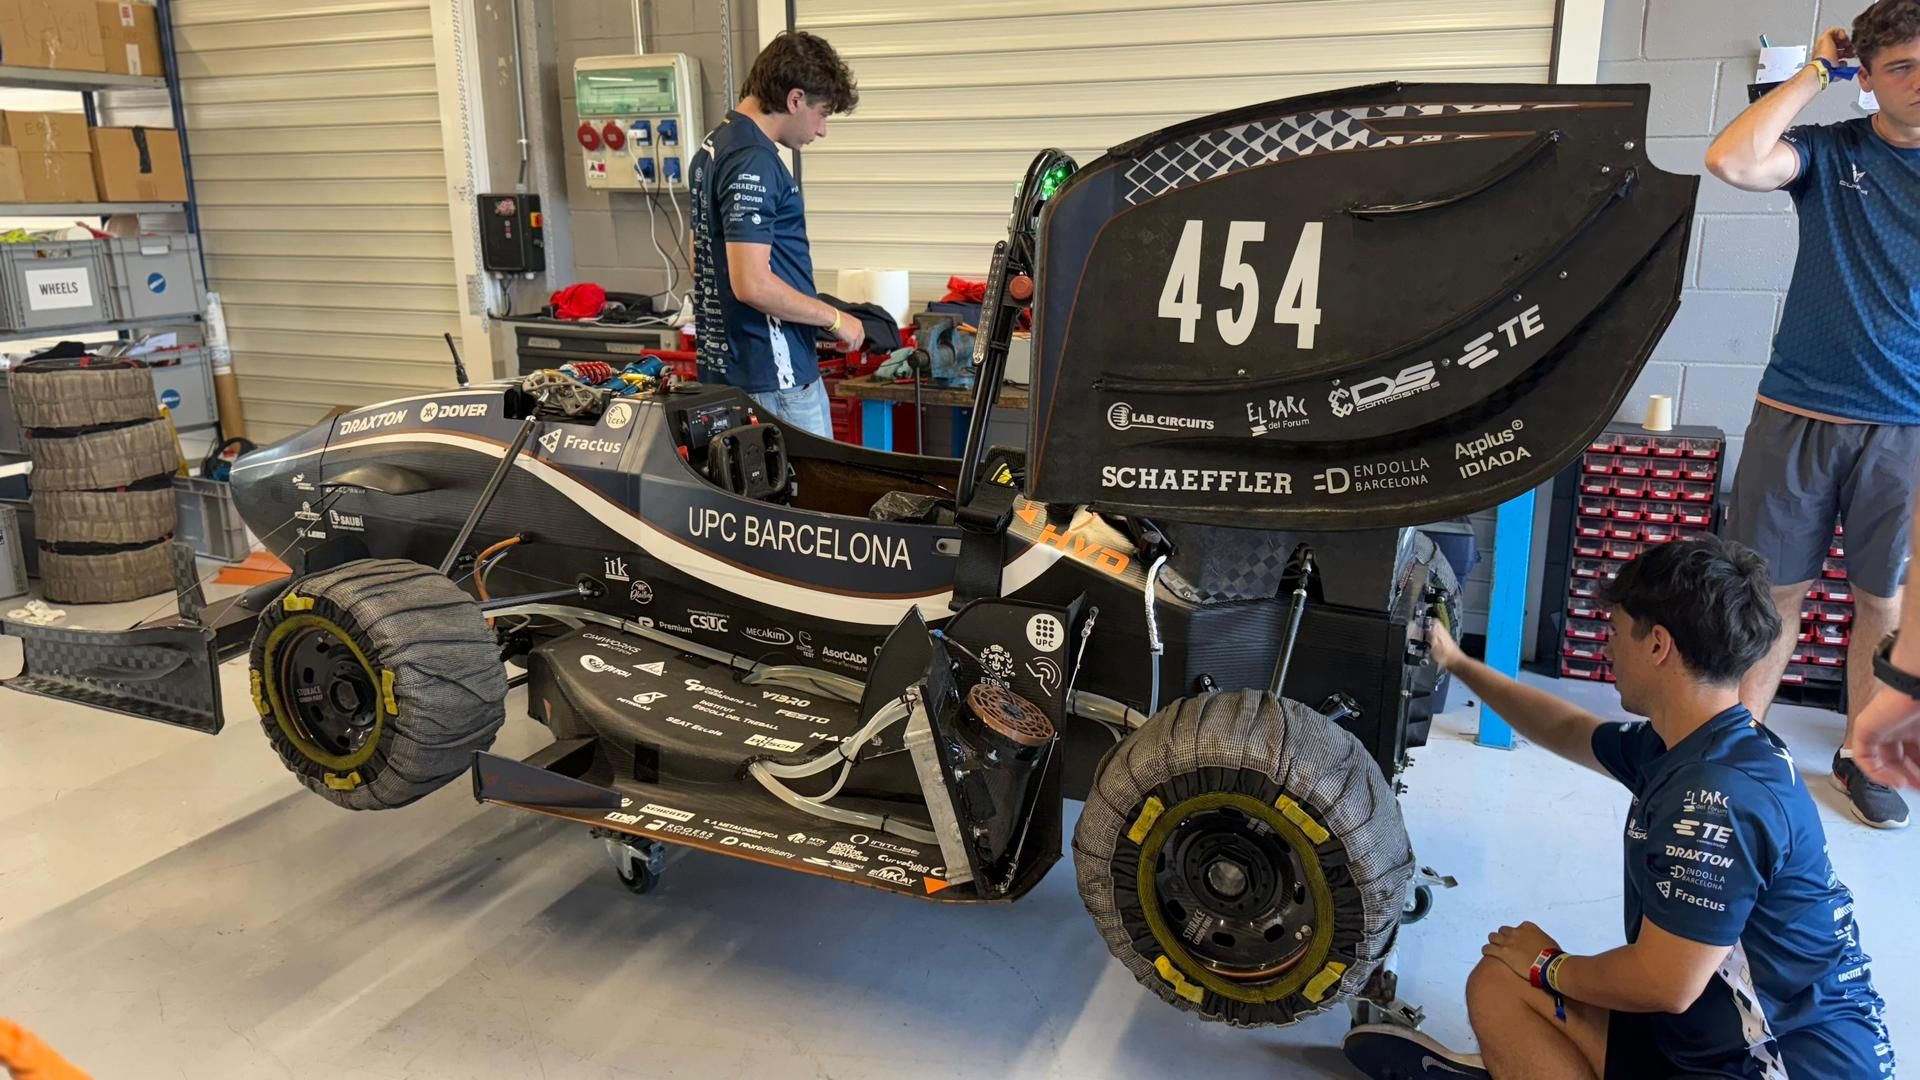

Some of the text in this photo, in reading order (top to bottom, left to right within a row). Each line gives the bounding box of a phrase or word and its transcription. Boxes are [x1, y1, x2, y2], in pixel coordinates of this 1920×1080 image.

[39, 282, 79, 295] WHEELS
[1158, 219, 1324, 350] 454
[1498, 304, 1545, 348] TE
[1350, 360, 1436, 406] DS
[438, 403, 488, 418] DOVER
[1246, 395, 1309, 425] EL PARC
[339, 409, 408, 436] DRAXTON
[1131, 413, 1215, 430] LAB CIRCUITS
[1268, 418, 1310, 430] del Forum
[563, 435, 622, 454] Fractus
[1455, 427, 1515, 460] Applus
[1354, 457, 1430, 478] ENDOLLA
[1459, 446, 1532, 479] IDIADA
[1102, 465, 1293, 495] SCHAEFFLER
[1355, 474, 1429, 492] BARCELONA
[688, 506, 912, 571] UPC BARCELONA
[604, 556, 629, 577] itk
[659, 621, 693, 634] Premium
[690, 614, 728, 633] CSUC
[1035, 638, 1054, 648] UPC
[980, 677, 1011, 689] ETSEB
[665, 716, 693, 727] SEAT
[775, 708, 831, 724] FESTO
[1700, 789, 1730, 809] PARC
[667, 823, 715, 838] ROGERS
[1702, 822, 1734, 844] TE
[1665, 845, 1735, 868] DRAXTON
[1682, 876, 1723, 890] BARCELONA
[1686, 867, 1726, 883] ENDOLLA
[1675, 888, 1726, 912] Fractus
